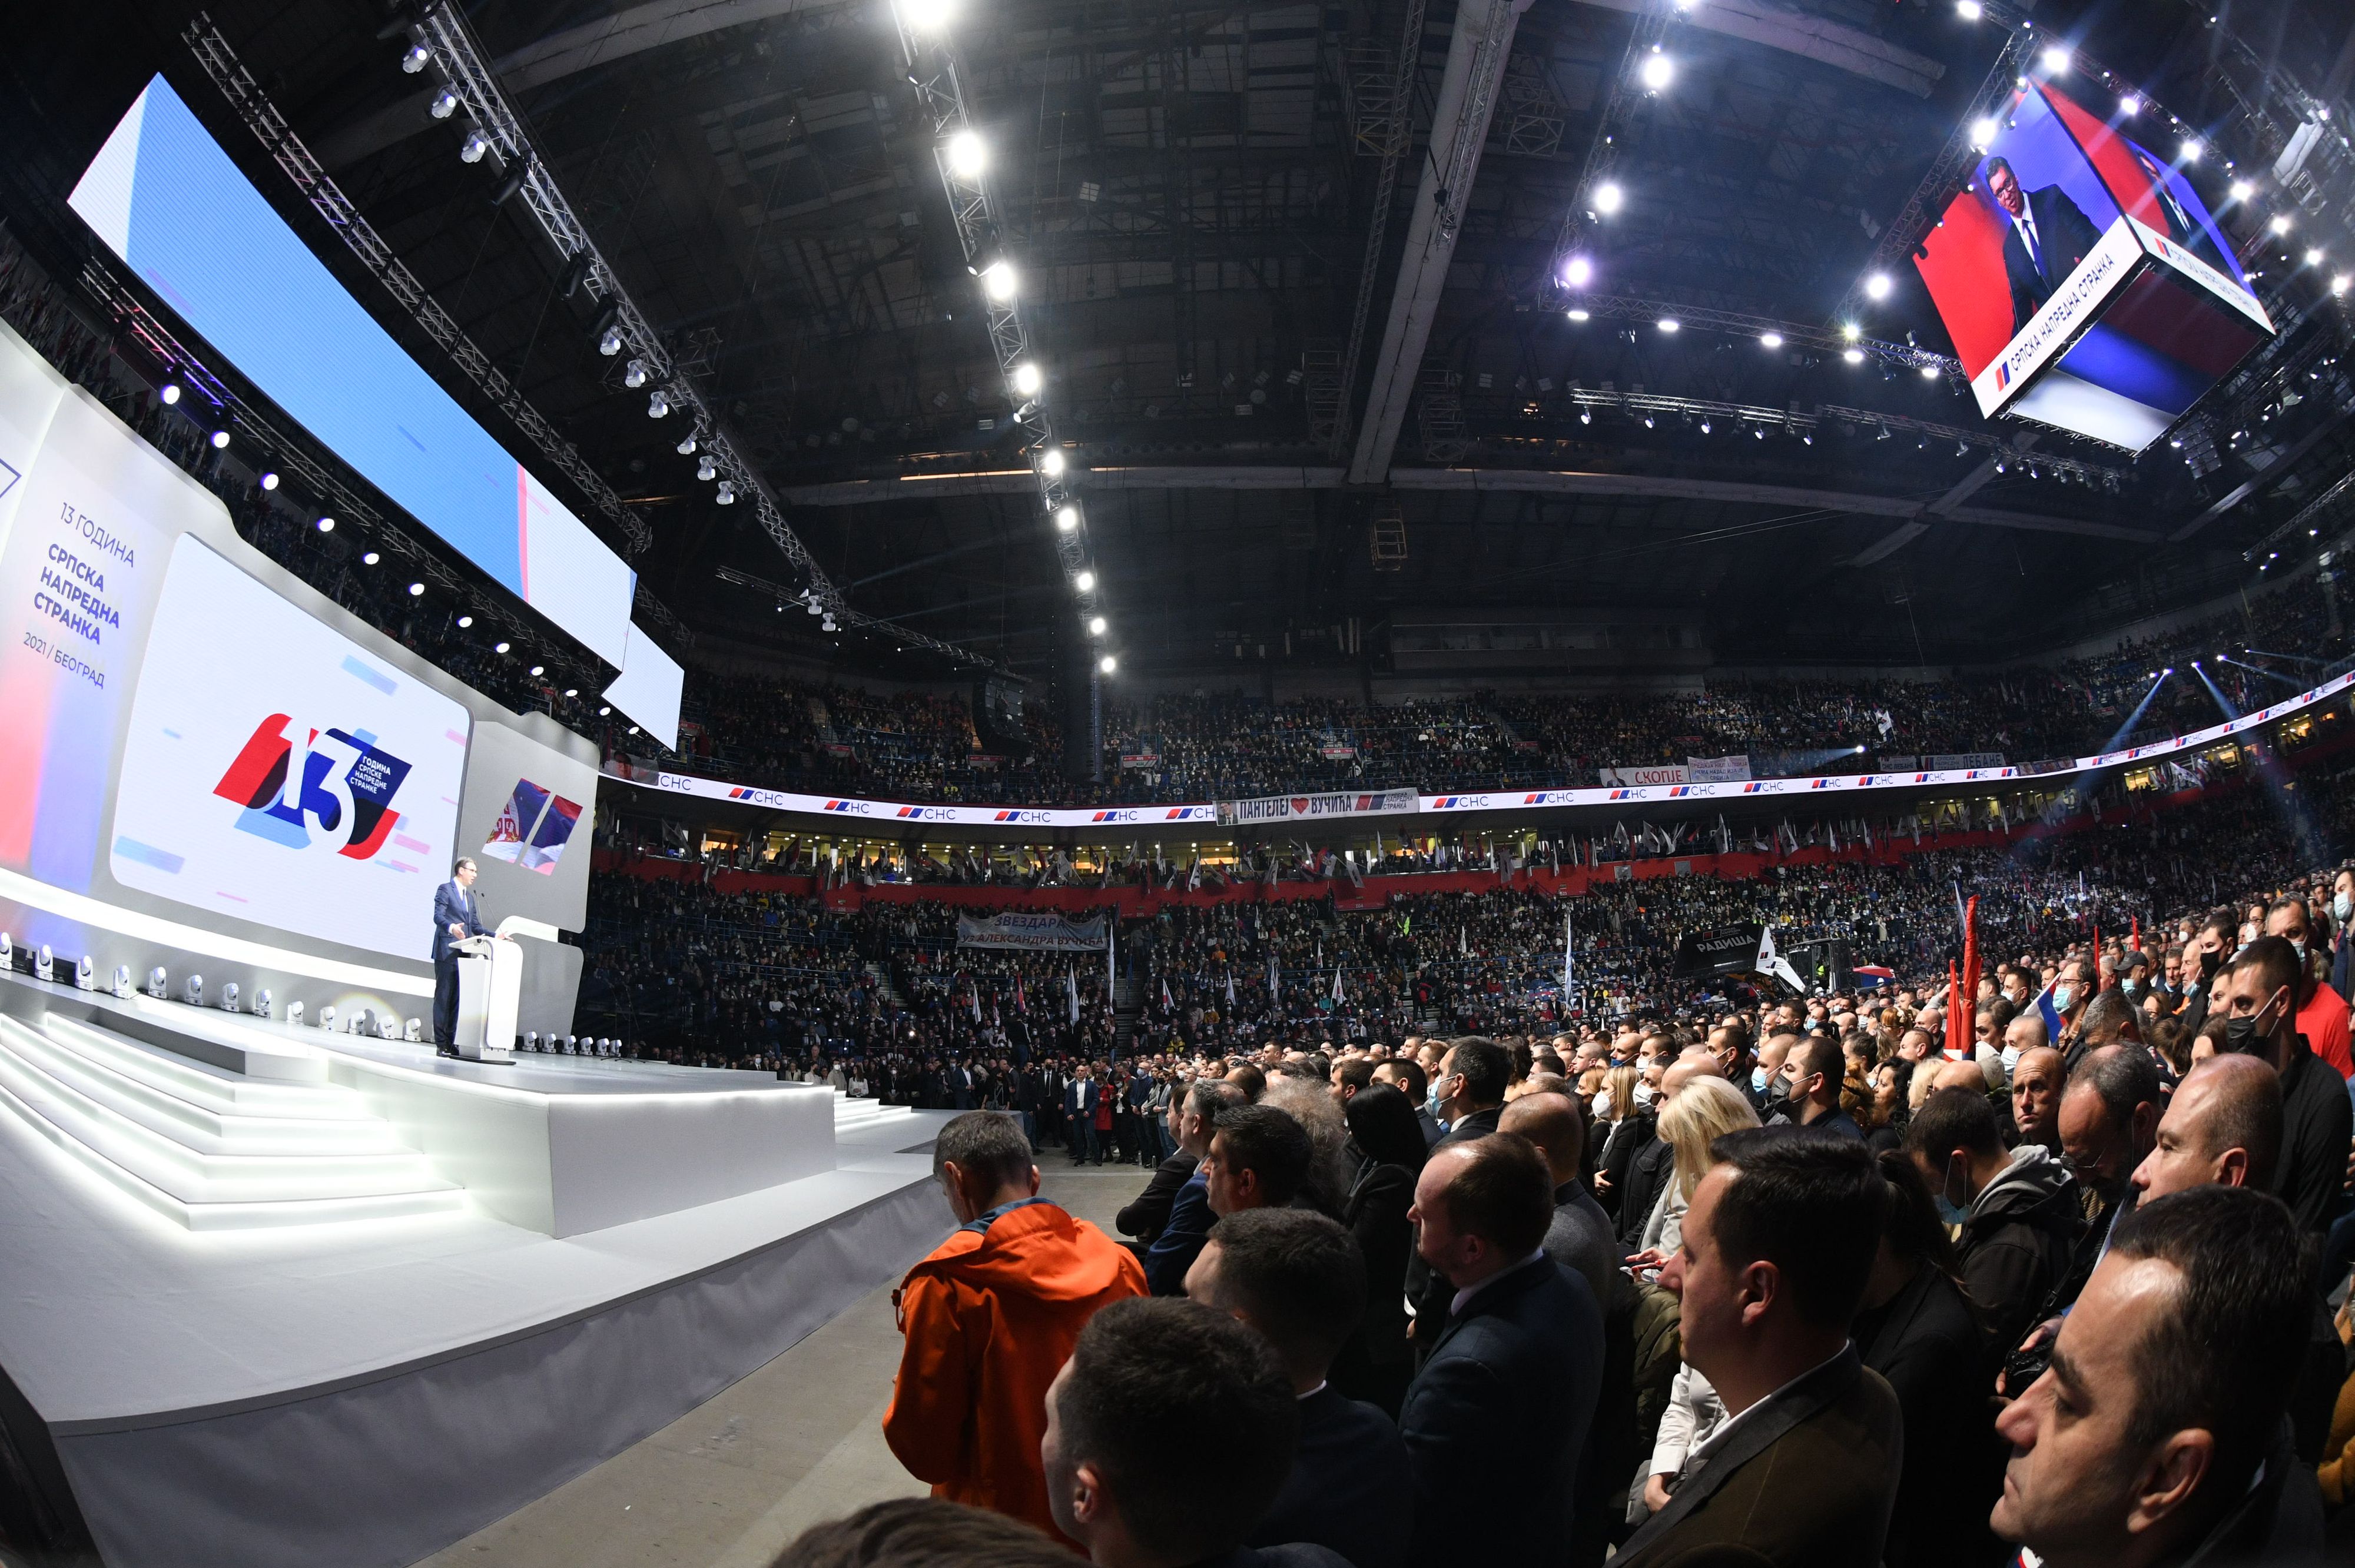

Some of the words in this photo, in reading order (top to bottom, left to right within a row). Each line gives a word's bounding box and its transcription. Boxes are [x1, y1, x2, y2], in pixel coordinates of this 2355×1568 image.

[2011, 334, 2042, 371] СРПСКА
[2039, 291, 2081, 341] НАПРЕДНА
[2078, 253, 2115, 298] СТРАНКА
[60, 502, 75, 524] 13
[76, 514, 134, 567] ГОДИНА
[48, 543, 104, 592] СРПСКА
[40, 567, 119, 629] НАПРЕДНА
[34, 592, 100, 645] СТРАНКА
[24, 632, 47, 653] 2021
[54, 650, 105, 689] БЕОГРАД
[363, 756, 391, 775] ГОДИНА
[1963, 755, 2001, 768] ЛЕБАНЕ
[359, 763, 382, 779] СРПСКЕ
[1635, 770, 1683, 784] СКОПЈЕ
[1929, 772, 1945, 782] СНС
[350, 777, 377, 794] СТРАНКЕ
[355, 770, 387, 790] НАПРЕДНЕ
[660, 775, 691, 790] СНС
[1762, 782, 1783, 792] СНС
[1825, 779, 1841, 788] НС
[1875, 776, 1893, 785] СНС
[1626, 789, 1647, 799] НС
[1691, 785, 1715, 796] СНС
[754, 791, 783, 806] СНС
[1460, 796, 1488, 807] СНС
[1547, 793, 1574, 803] СНС
[844, 803, 870, 813] НС
[1194, 808, 1215, 819] СН
[1240, 798, 1289, 819] ПАНТЕЛЕЈ
[1311, 795, 1351, 814] ВУЧИЋА
[924, 809, 956, 820] СНС
[1021, 812, 1051, 822] СНС
[1112, 810, 1137, 821] НС
[994, 915, 1066, 931] ЗВЕЗДАРА
[978, 935, 1053, 946] АЛЕКСАНДРА
[1696, 935, 1757, 952] РАДИША
